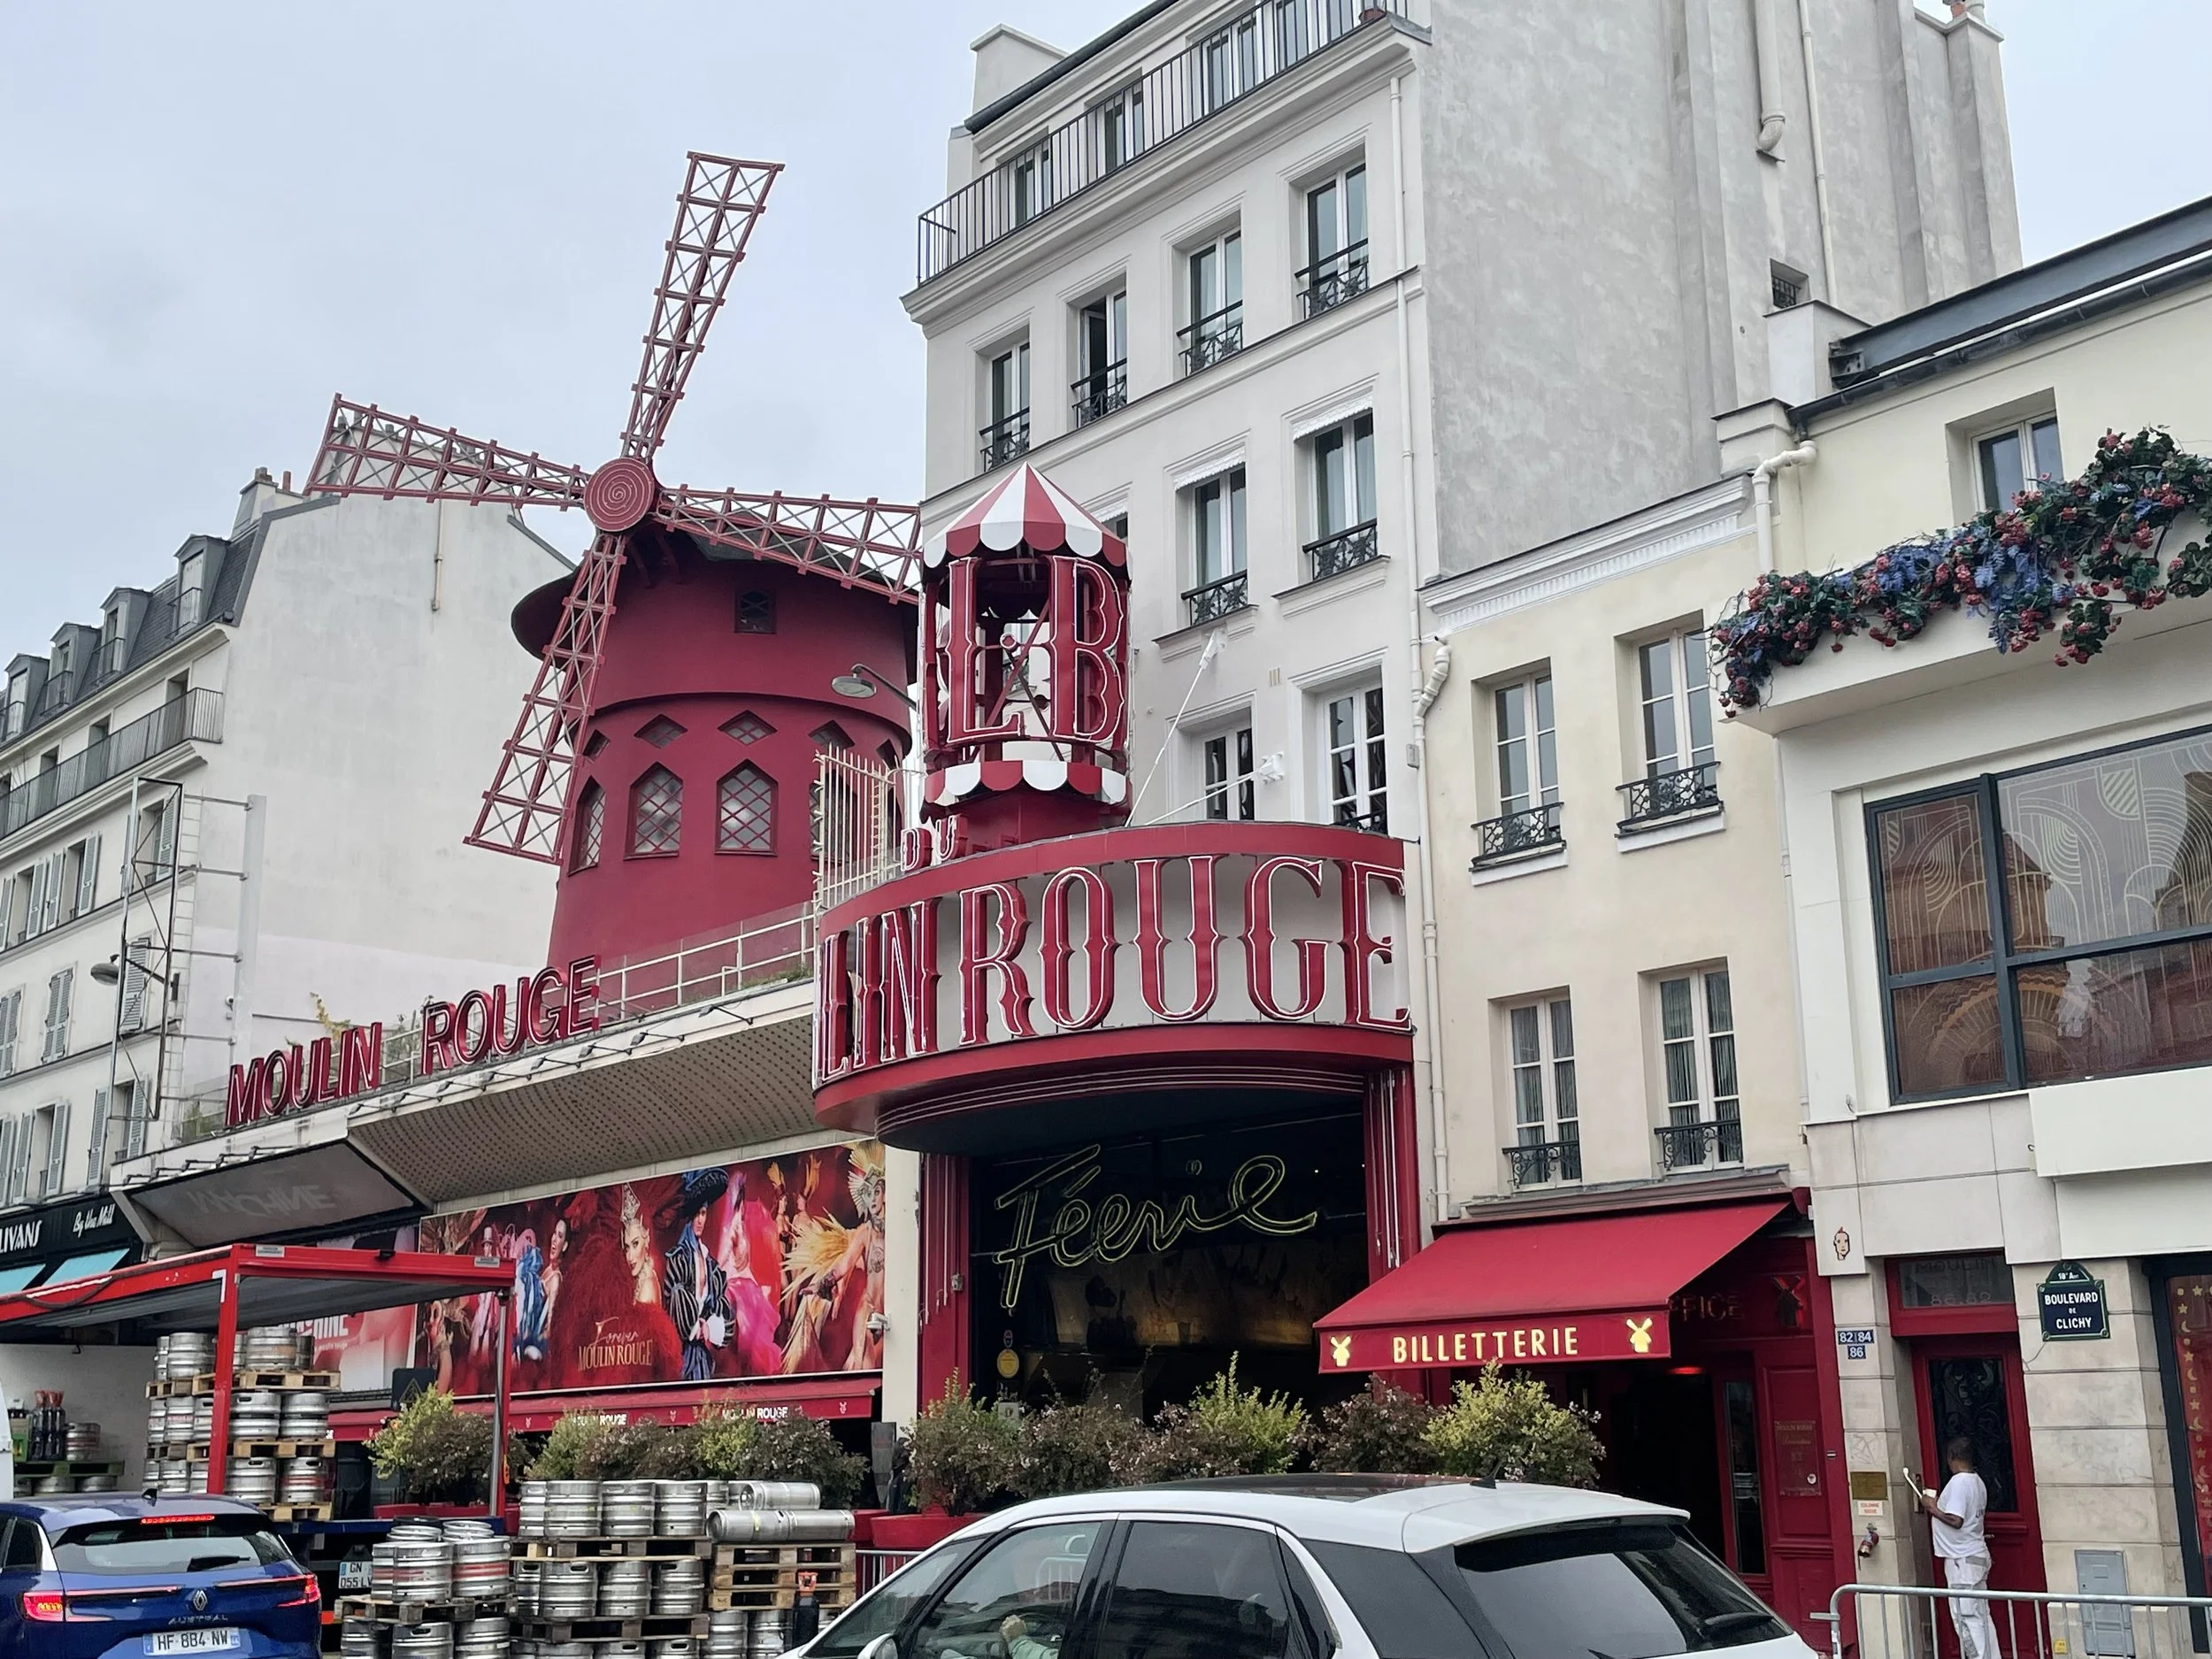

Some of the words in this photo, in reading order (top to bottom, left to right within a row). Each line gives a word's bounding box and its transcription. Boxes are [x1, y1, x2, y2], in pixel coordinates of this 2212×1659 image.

[901, 814, 967, 872] DU
[958, 853, 1412, 1046] ROUGE
[223, 1022, 382, 1128] MOULIN
[420, 955, 601, 1075] ROUGE
[0, 1220, 42, 1254] LIVANS
[73, 1211, 84, 1238] By
[2044, 1292, 2099, 1306] BOULEVARD
[1839, 1332, 1854, 1342] 82
[1857, 1331, 1872, 1342] 84
[2055, 1317, 2093, 1330] CLICHY
[578, 1344, 615, 1371] MOULIN
[617, 1339, 653, 1366] ROUGE
[1393, 1326, 1578, 1363] BILLETTERIE
[1849, 1347, 1863, 1357] 86
[757, 1407, 788, 1419] ROUGE
